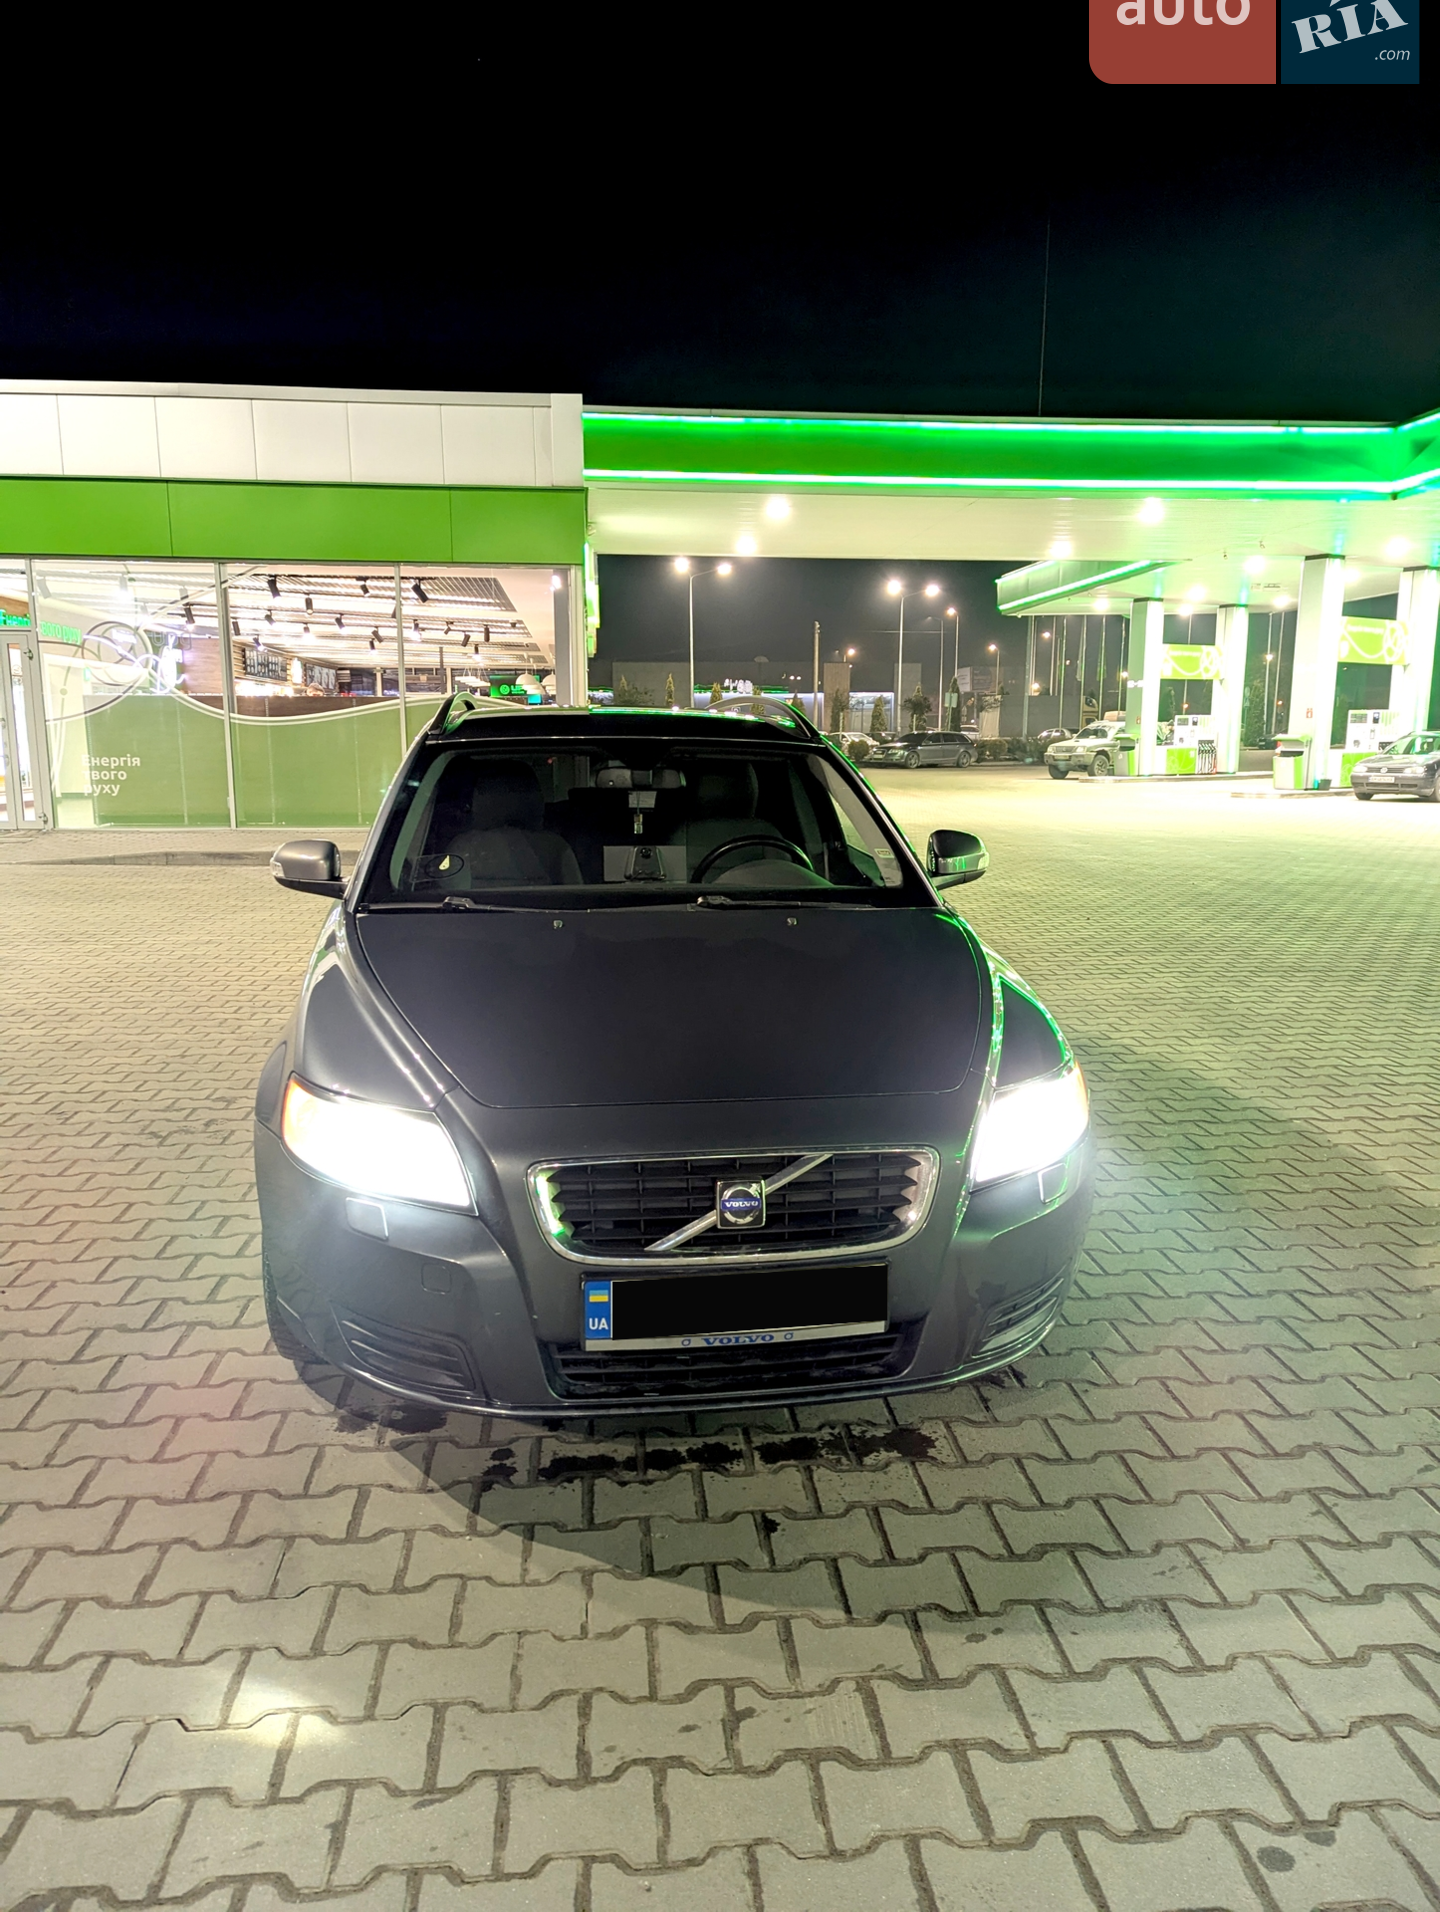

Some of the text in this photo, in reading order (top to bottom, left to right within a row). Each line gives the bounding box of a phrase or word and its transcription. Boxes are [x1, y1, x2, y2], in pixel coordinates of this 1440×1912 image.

[0, 609, 31, 626] Енергі
[40, 620, 62, 638] вого
[81, 754, 141, 769] Енергія
[82, 770, 127, 780] твого
[83, 784, 120, 796] руху
[724, 1200, 759, 1208] VOLVO
[588, 1317, 609, 1331] UA
[701, 1333, 775, 1346] VOLVO
